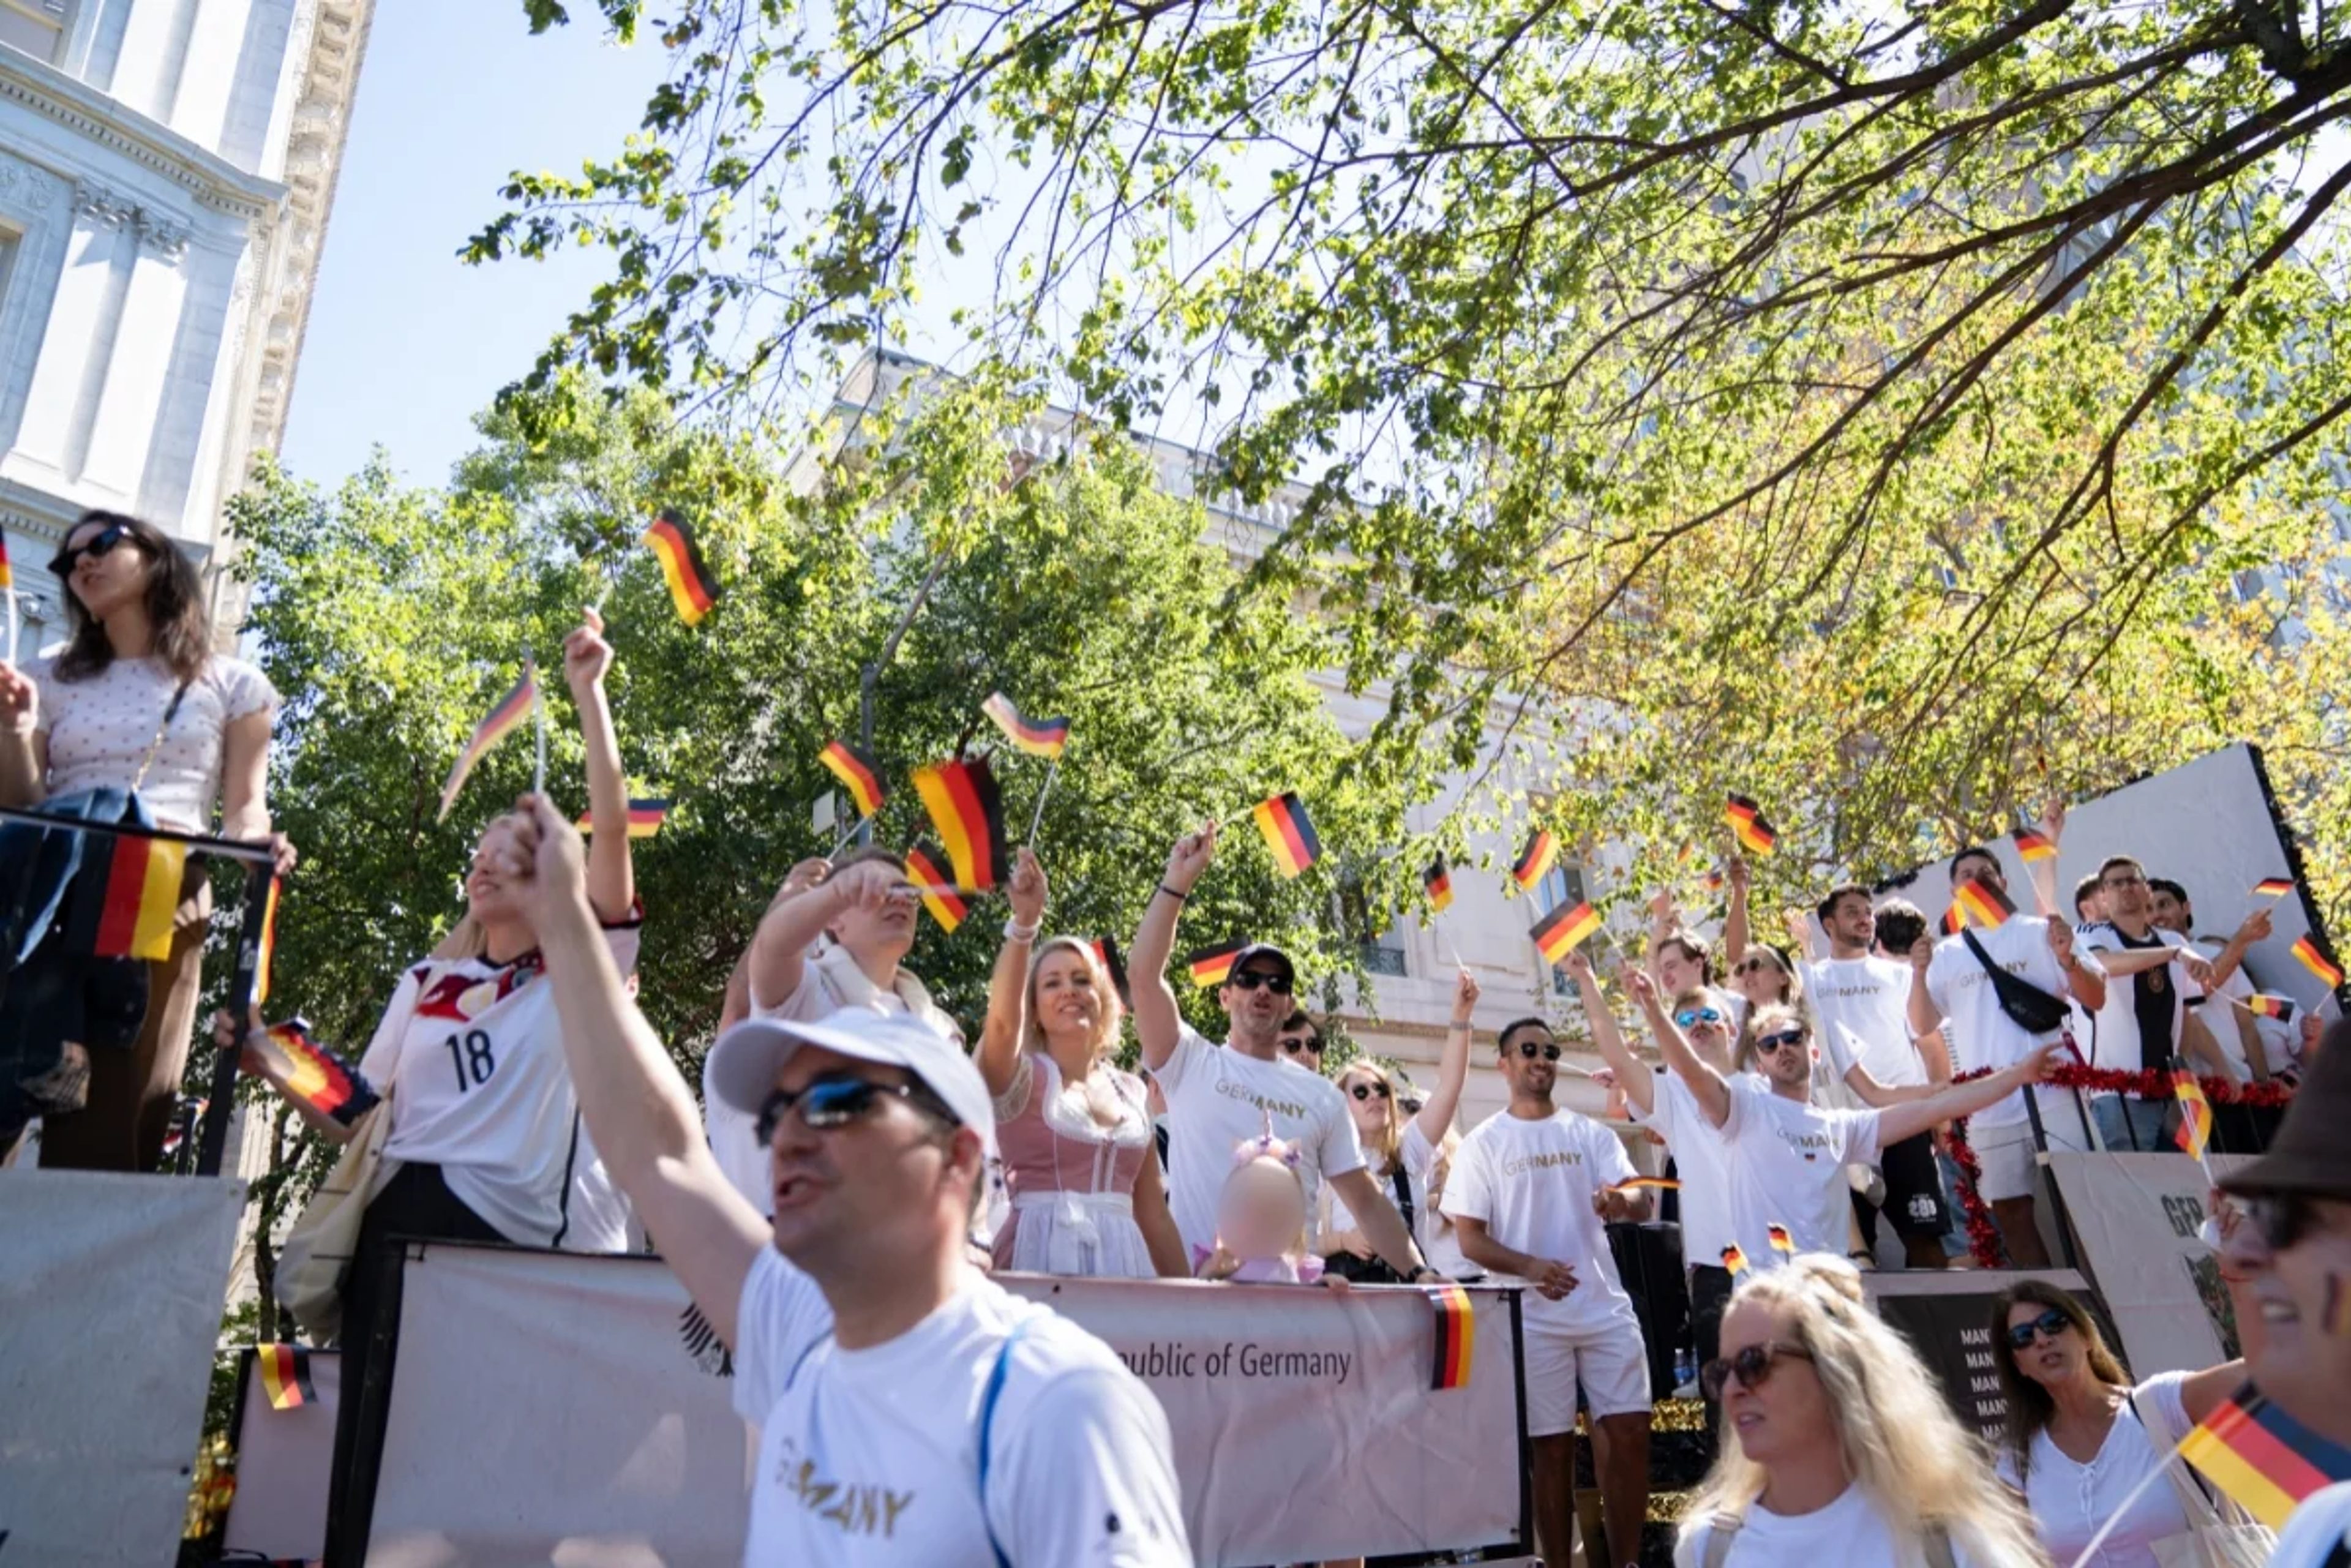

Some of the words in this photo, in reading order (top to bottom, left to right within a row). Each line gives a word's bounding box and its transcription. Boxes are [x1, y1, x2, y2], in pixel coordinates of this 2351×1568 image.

[445, 1029, 495, 1093] 18
[1204, 1342, 1233, 1377] of
[1239, 1343, 1351, 1384] Germany
